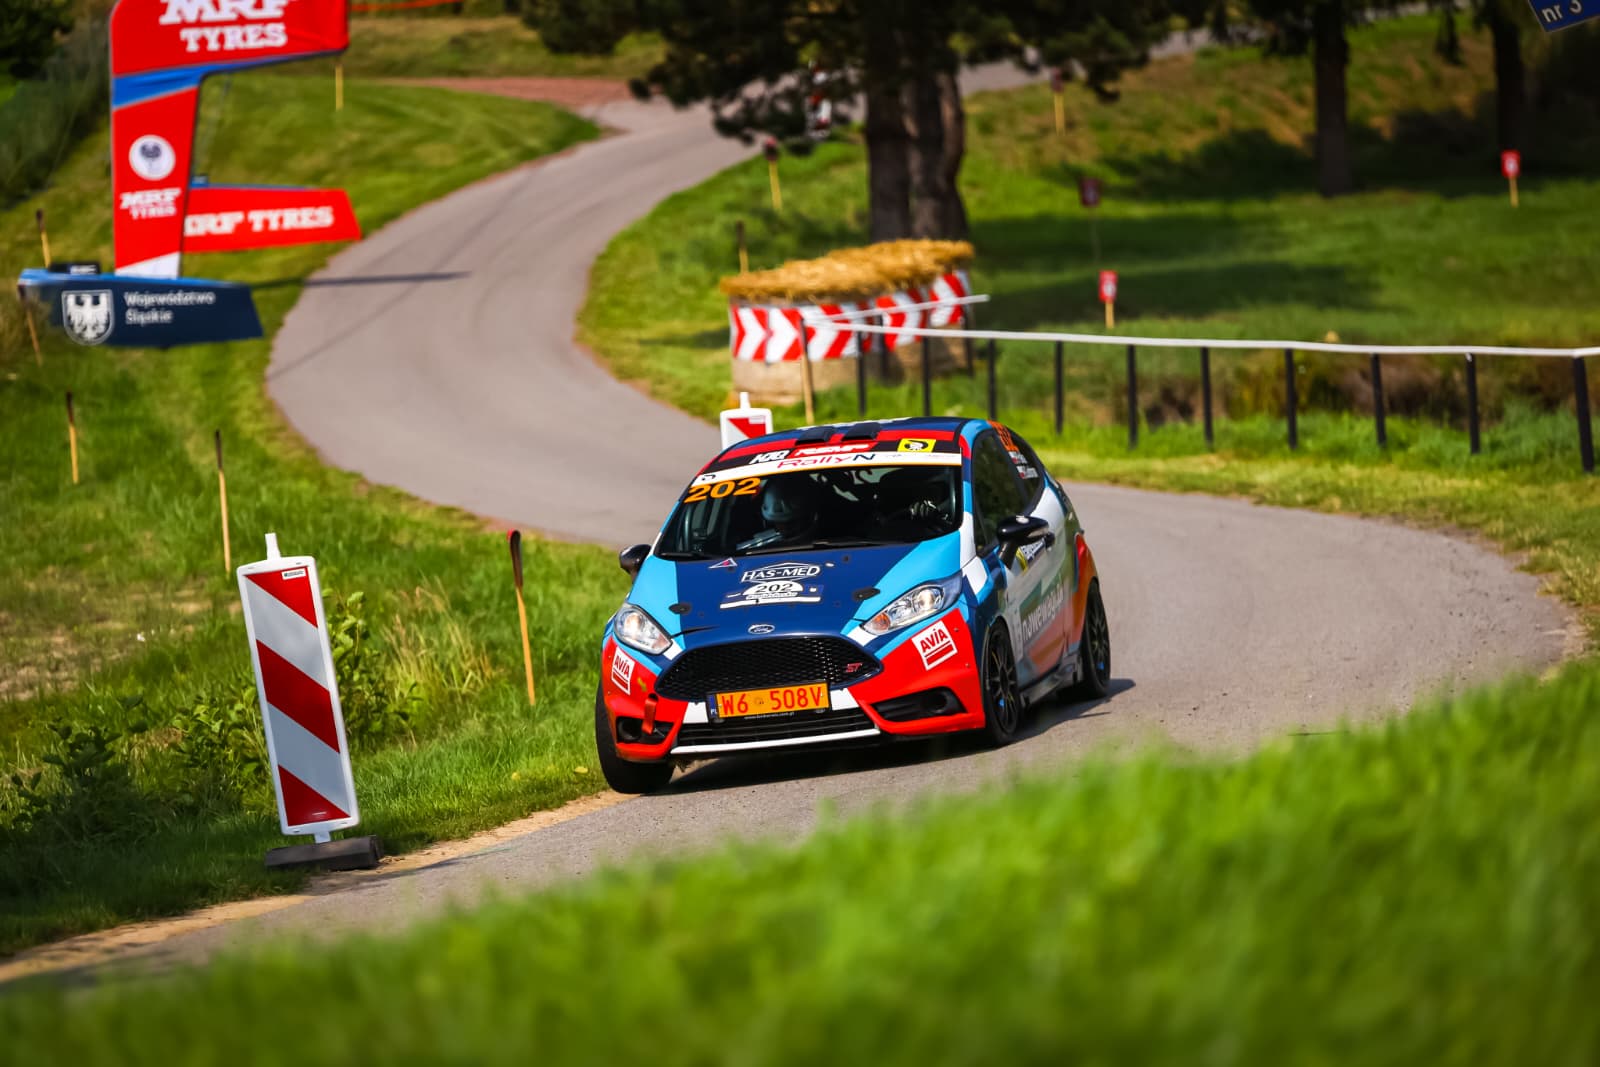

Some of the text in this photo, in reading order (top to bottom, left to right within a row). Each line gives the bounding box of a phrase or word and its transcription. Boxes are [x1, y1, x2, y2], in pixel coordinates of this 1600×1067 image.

[180, 22, 287, 52] TYRES
[120, 188, 181, 209] MRF
[248, 206, 335, 232] TYRES
[684, 477, 761, 503] 202
[740, 566, 821, 583] HAS-MED
[755, 583, 794, 593] 202
[721, 686, 822, 715] W6 508V
